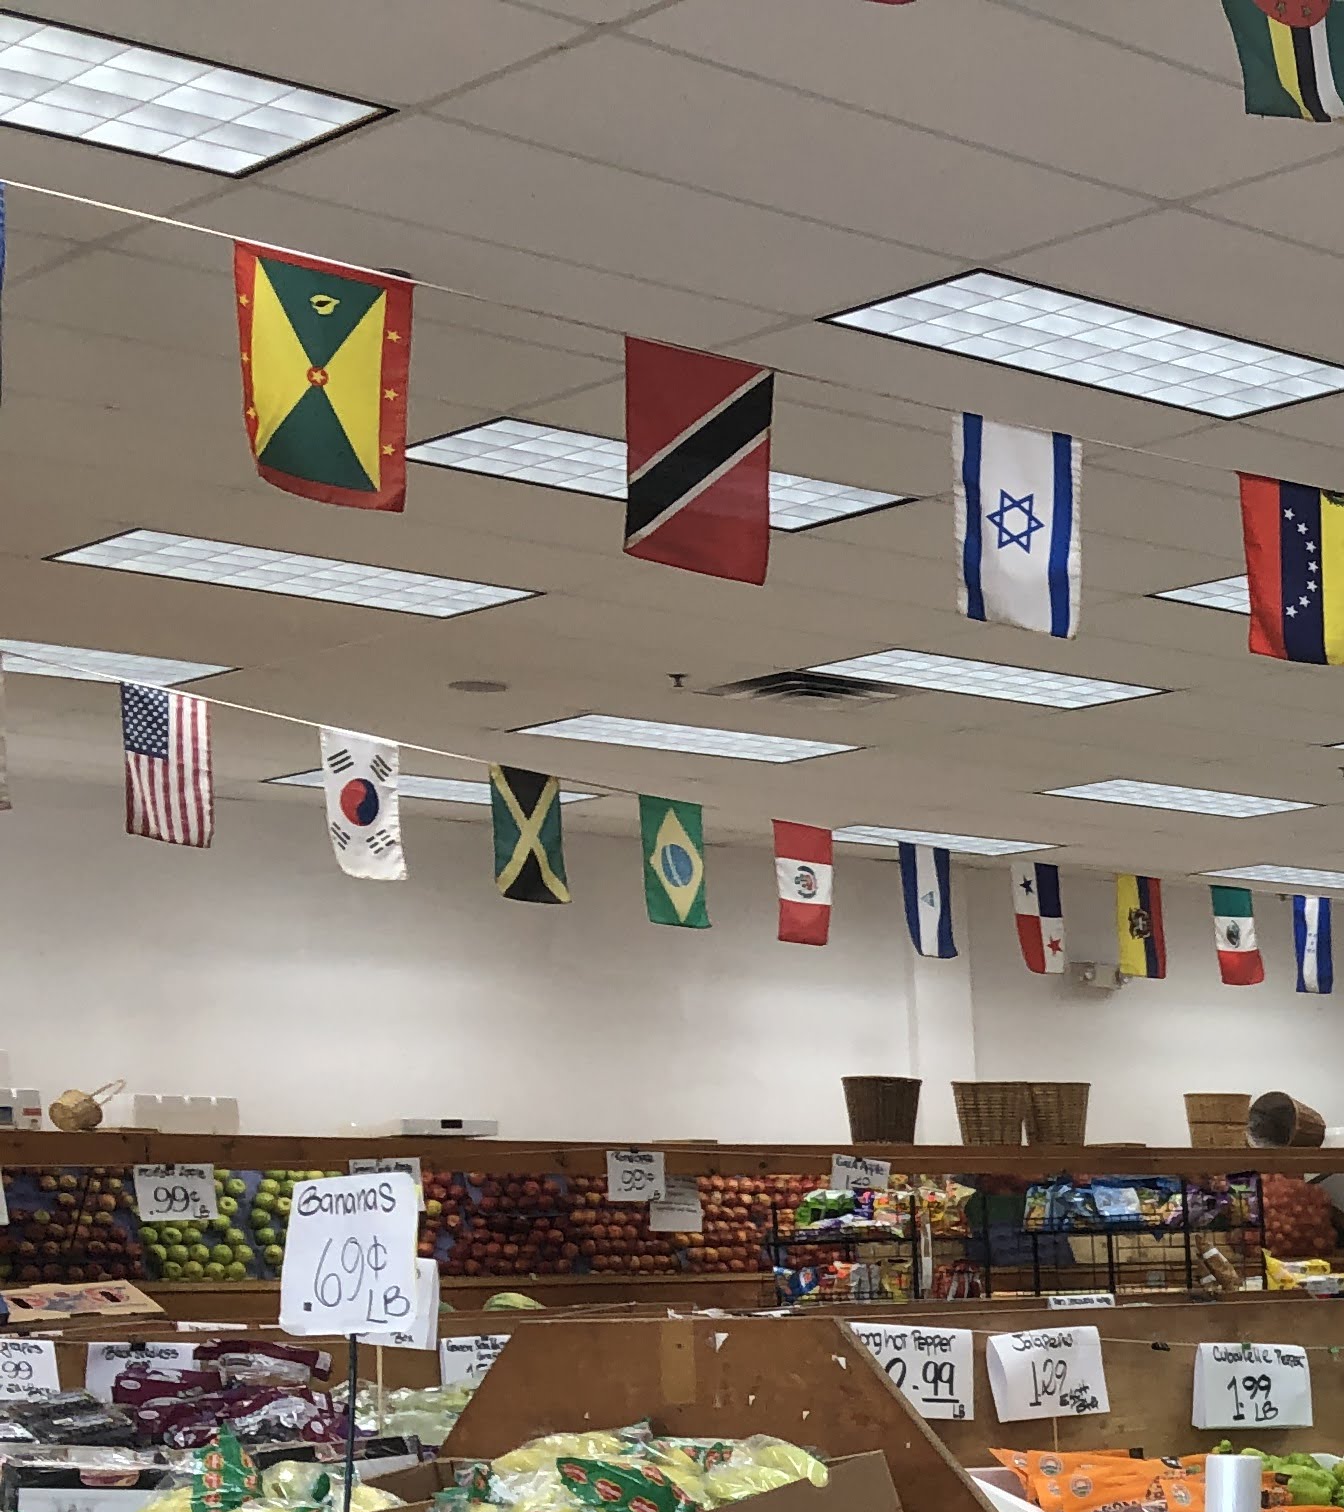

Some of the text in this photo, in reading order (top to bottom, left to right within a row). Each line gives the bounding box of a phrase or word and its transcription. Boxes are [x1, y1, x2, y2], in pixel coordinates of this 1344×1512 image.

[366, 1285, 411, 1324] LB
[952, 1404, 966, 1419] LB
[1227, 1374, 1272, 1421] 1.99
[1254, 1399, 1279, 1422] LB
